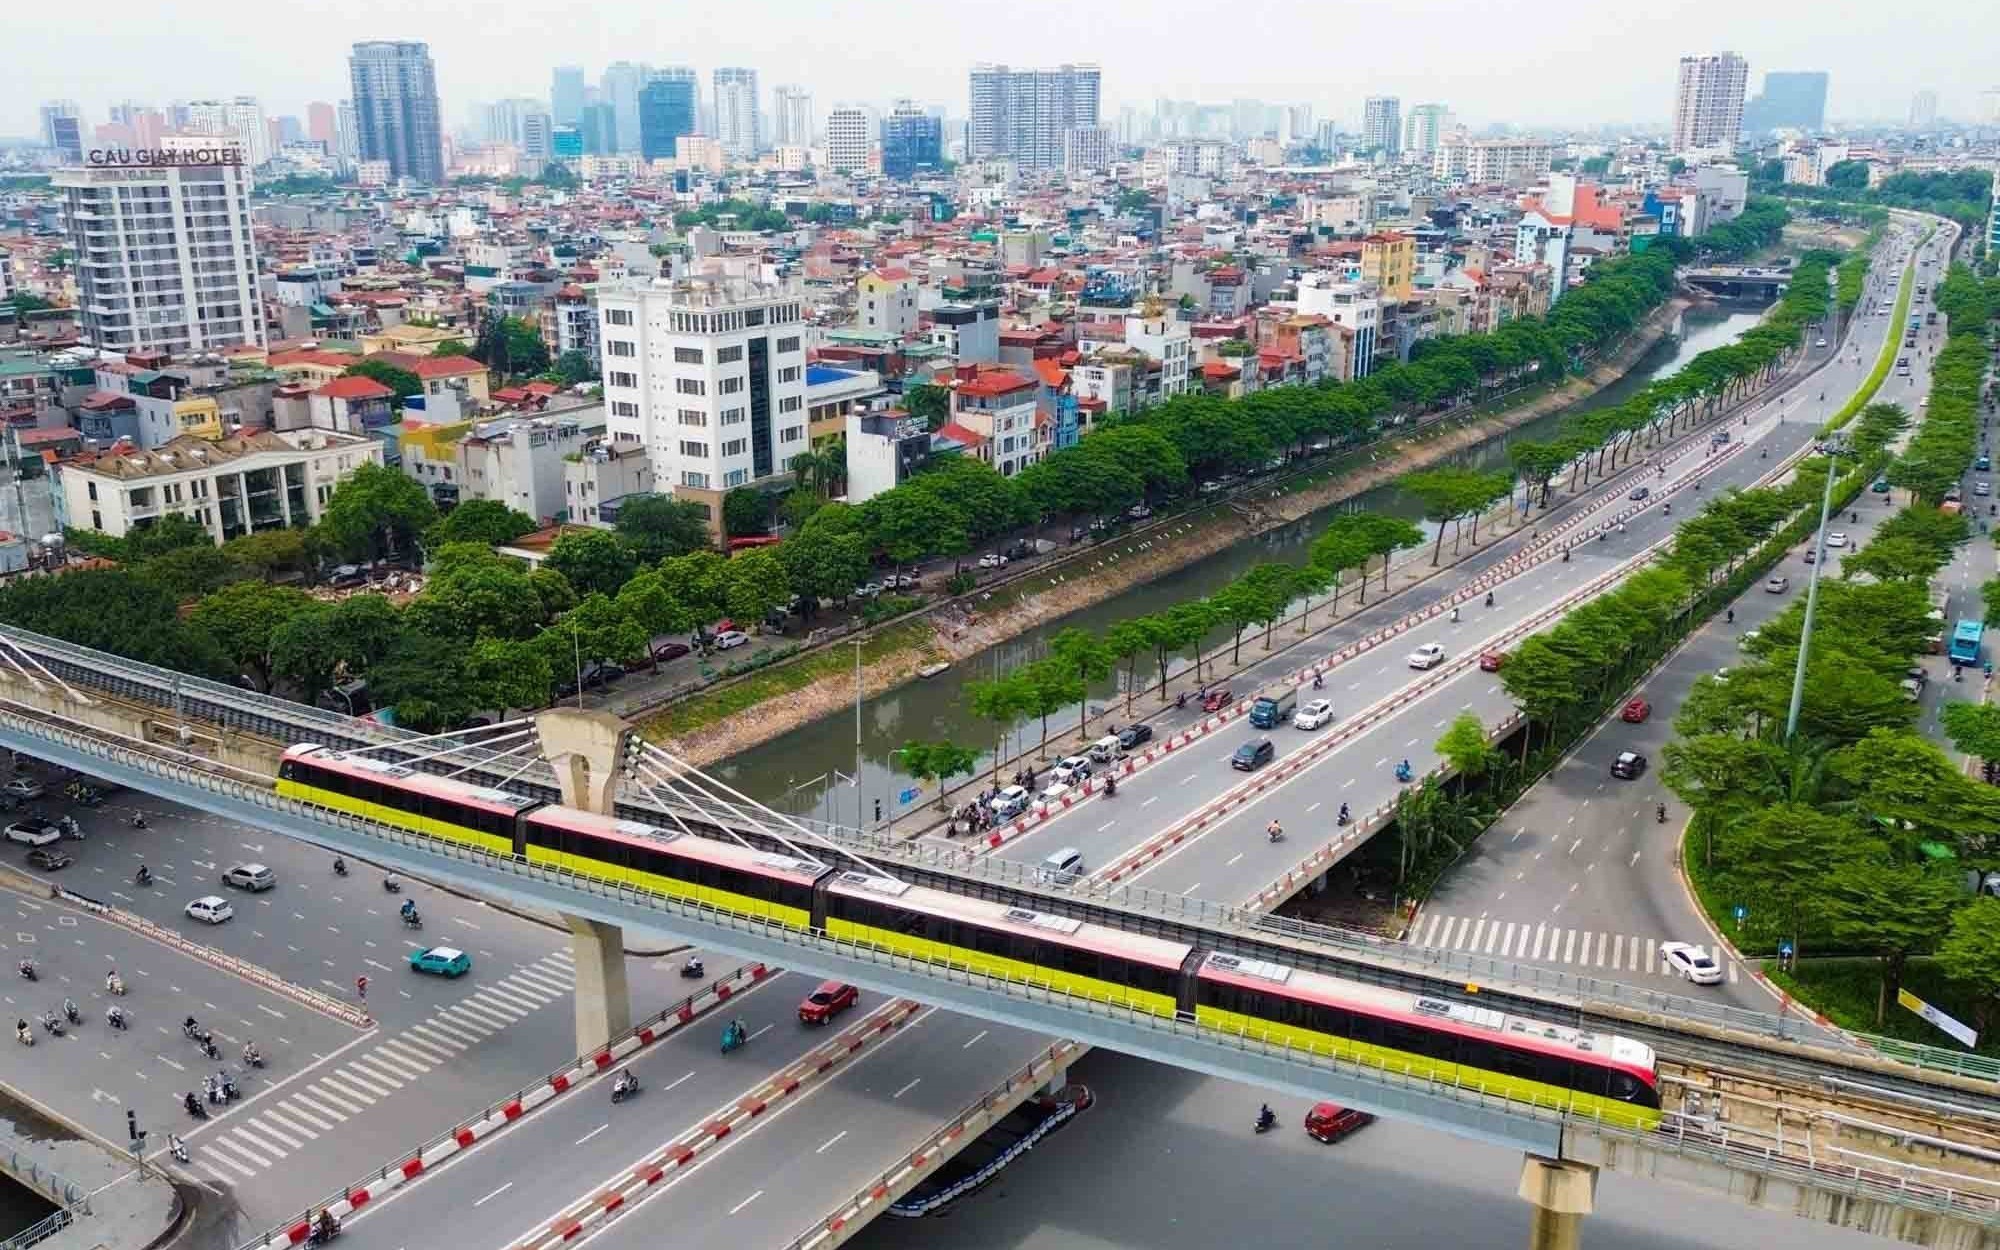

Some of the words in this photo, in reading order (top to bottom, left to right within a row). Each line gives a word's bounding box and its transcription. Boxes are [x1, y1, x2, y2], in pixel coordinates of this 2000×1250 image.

[89, 149, 130, 164] CAU
[136, 149, 177, 164] GIAY
[183, 147, 242, 163] HOTEL
